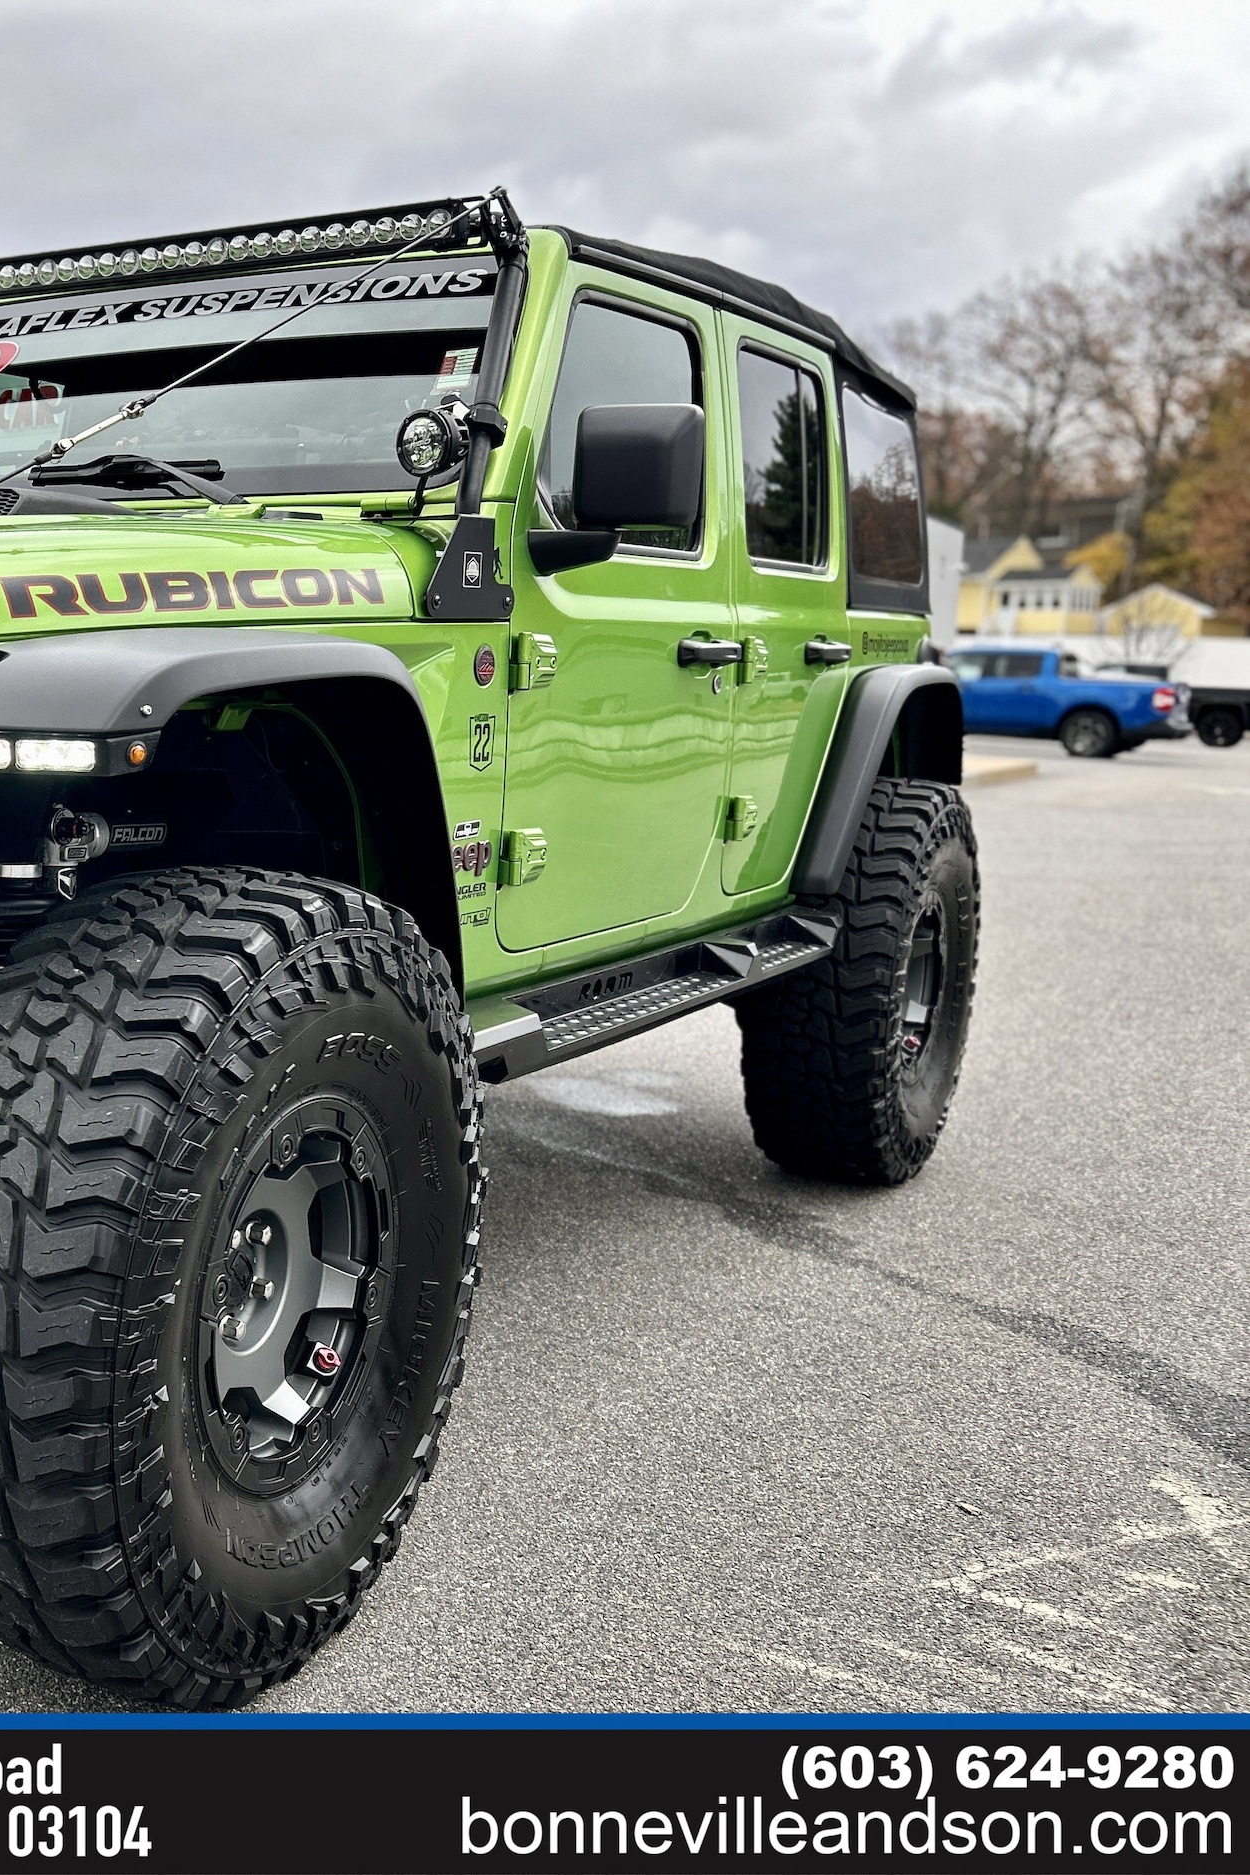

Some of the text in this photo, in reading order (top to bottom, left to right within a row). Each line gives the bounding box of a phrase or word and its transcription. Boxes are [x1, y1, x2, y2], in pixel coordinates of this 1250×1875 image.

[134, 268, 490, 323] SUSPENSIONS
[473, 723, 491, 763] 22
[112, 826, 164, 843] FALCON
[450, 840, 492, 877] eep
[225, 1478, 372, 1570] THOMPSON
